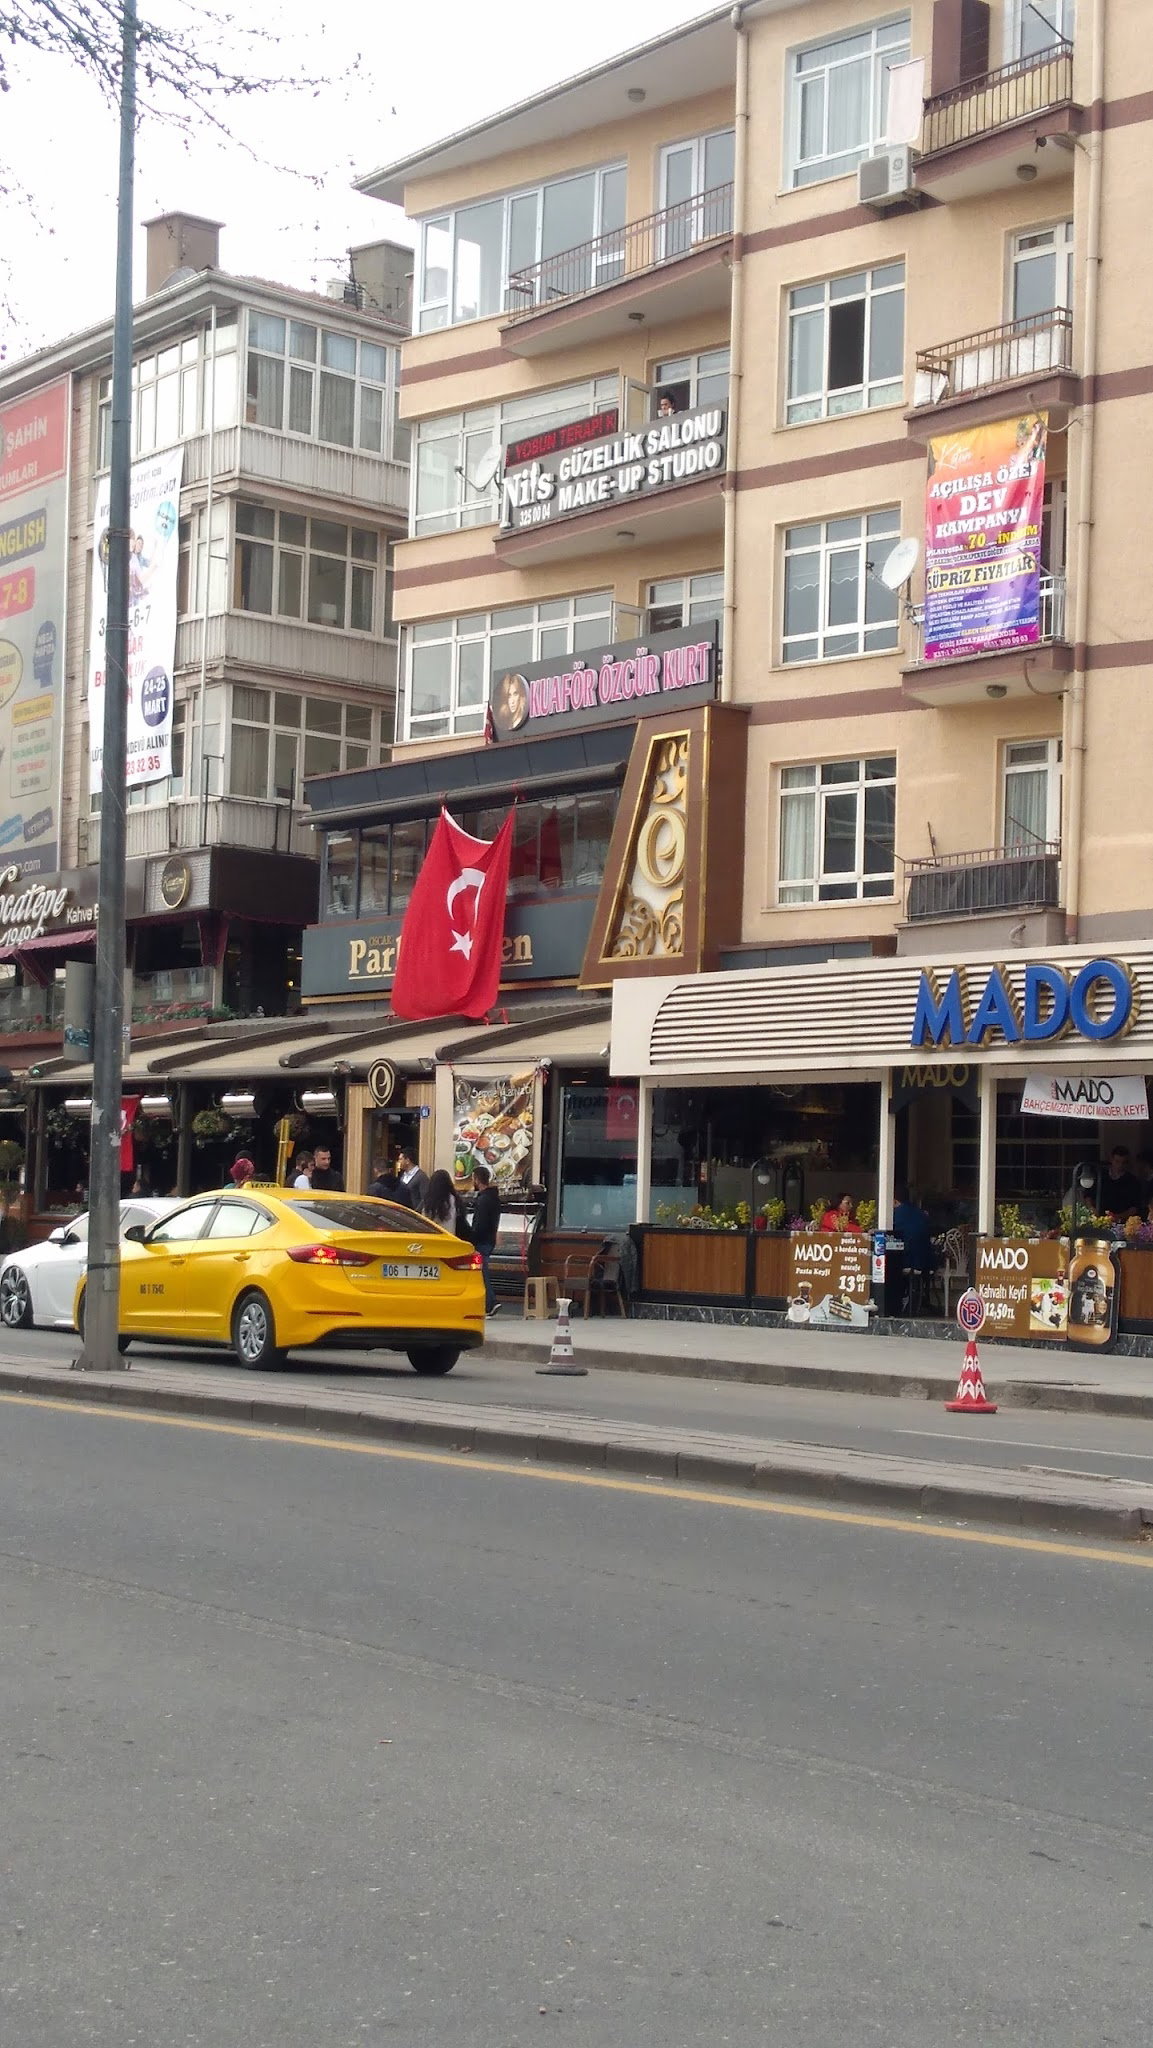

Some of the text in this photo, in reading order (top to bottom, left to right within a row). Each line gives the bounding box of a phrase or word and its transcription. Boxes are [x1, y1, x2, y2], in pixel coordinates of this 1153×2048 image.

[7, 416, 47, 458] ŞAHİN
[559, 409, 723, 482] GÜZELLİK SALONU
[558, 441, 723, 512] MAKE-UP STUDIO
[930, 471, 994, 499] AÇILIŞA
[960, 487, 1008, 516] DEV
[968, 532, 986, 551] 70
[143, 676, 167, 696] 24-25
[529, 660, 598, 719] KUAFÖR
[663, 641, 713, 691] KURT
[144, 697, 167, 717] MART
[148, 755, 161, 771] 35
[67, 905, 93, 925] Kahve
[911, 956, 1141, 1049] MADO
[901, 1064, 969, 1088] MADO
[1054, 1079, 1115, 1105] MADO
[794, 1244, 833, 1262] MADO
[980, 1248, 1029, 1270] MADO
[388, 1265, 399, 1277] 06
[404, 1265, 409, 1277] T
[418, 1266, 439, 1278] 7542
[839, 1275, 856, 1292] 13
[979, 1283, 1028, 1303] Kahvaltı Keyfi
